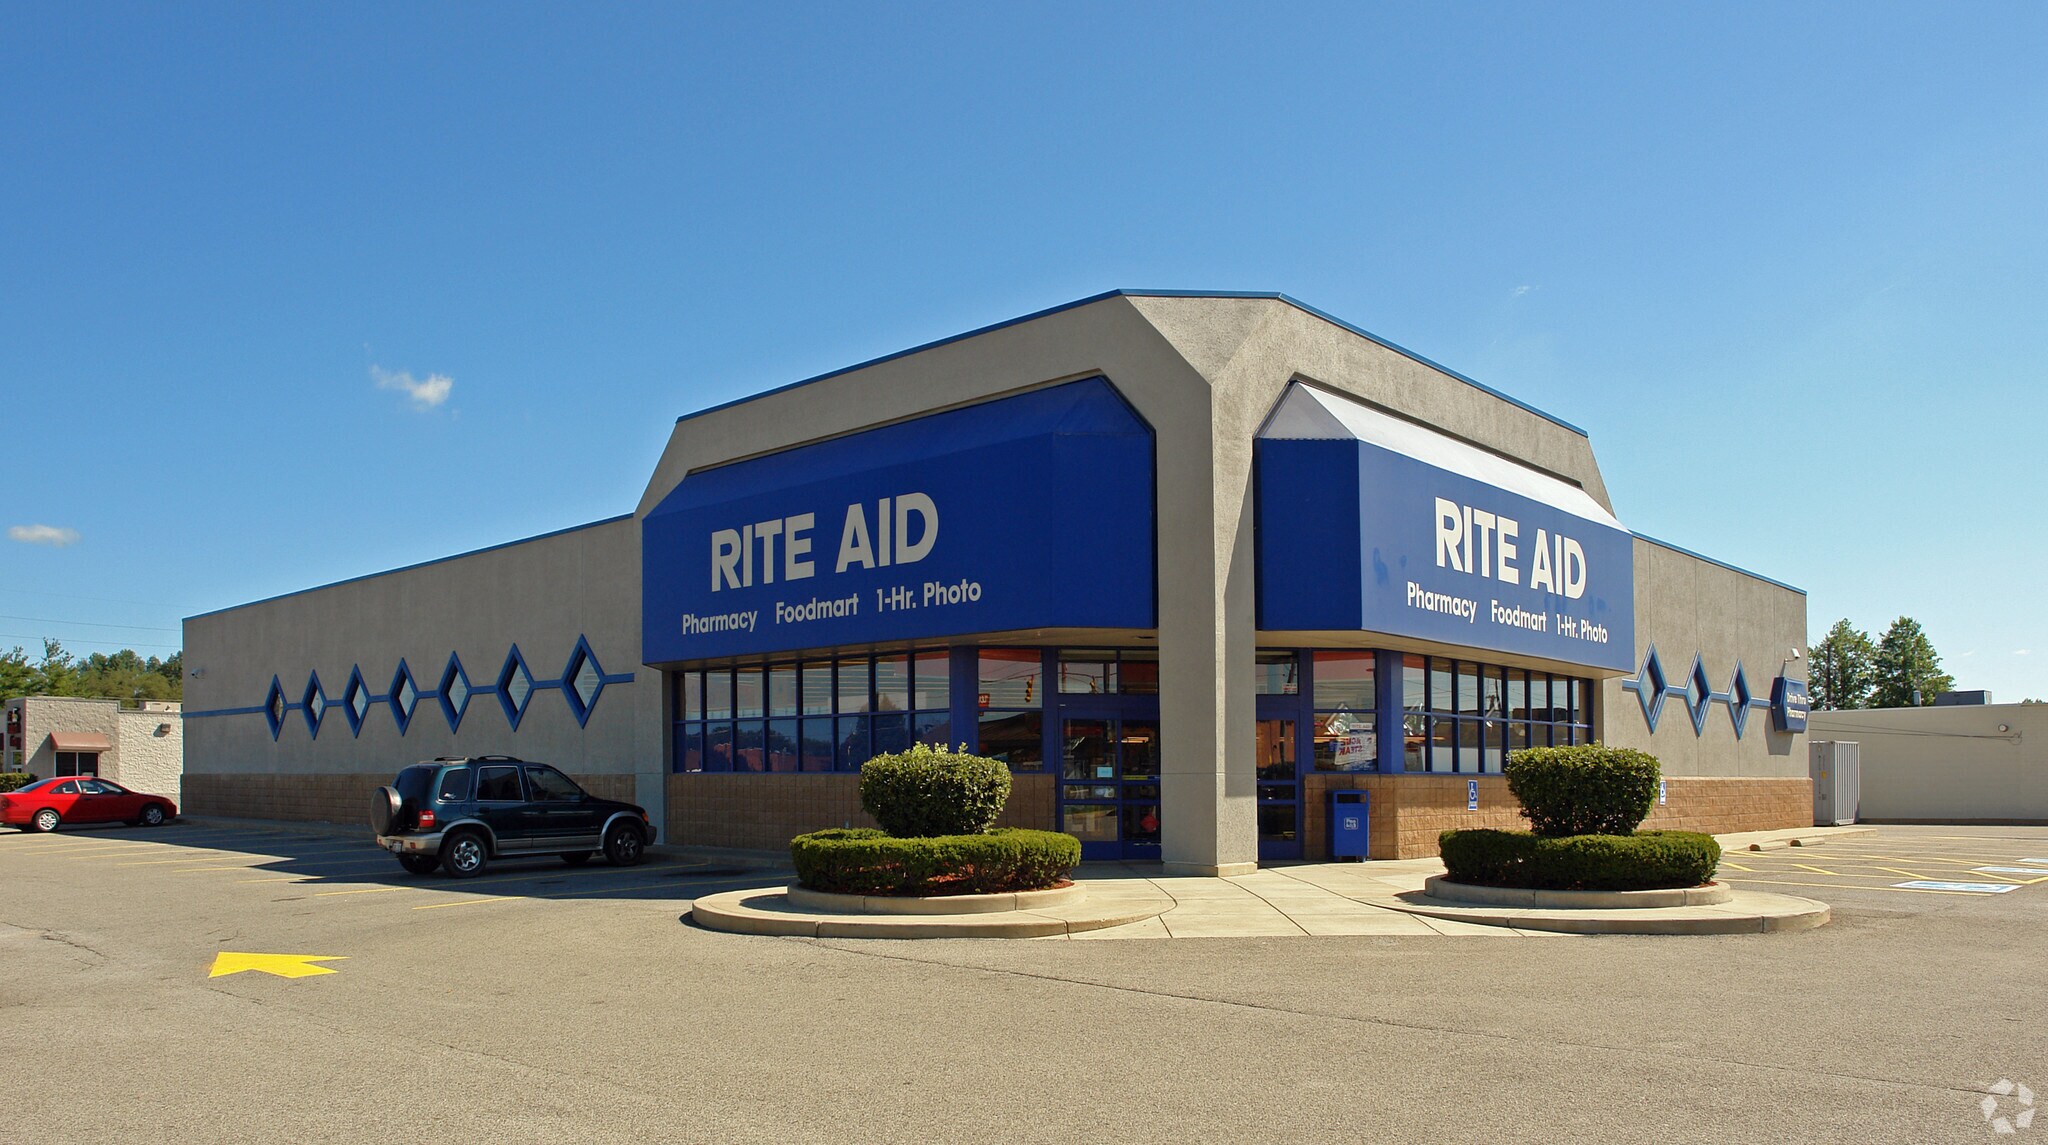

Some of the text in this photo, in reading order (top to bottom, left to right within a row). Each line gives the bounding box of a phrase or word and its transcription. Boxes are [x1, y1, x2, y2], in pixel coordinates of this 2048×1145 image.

[712, 492, 939, 592] RITE AID
[1435, 496, 1587, 600] RITE AID
[682, 578, 982, 635] Pharmacy Foodmart 1-Hr. Photo
[1407, 581, 1608, 644] Pharmacy Foodmart 1-Hr. Photo
